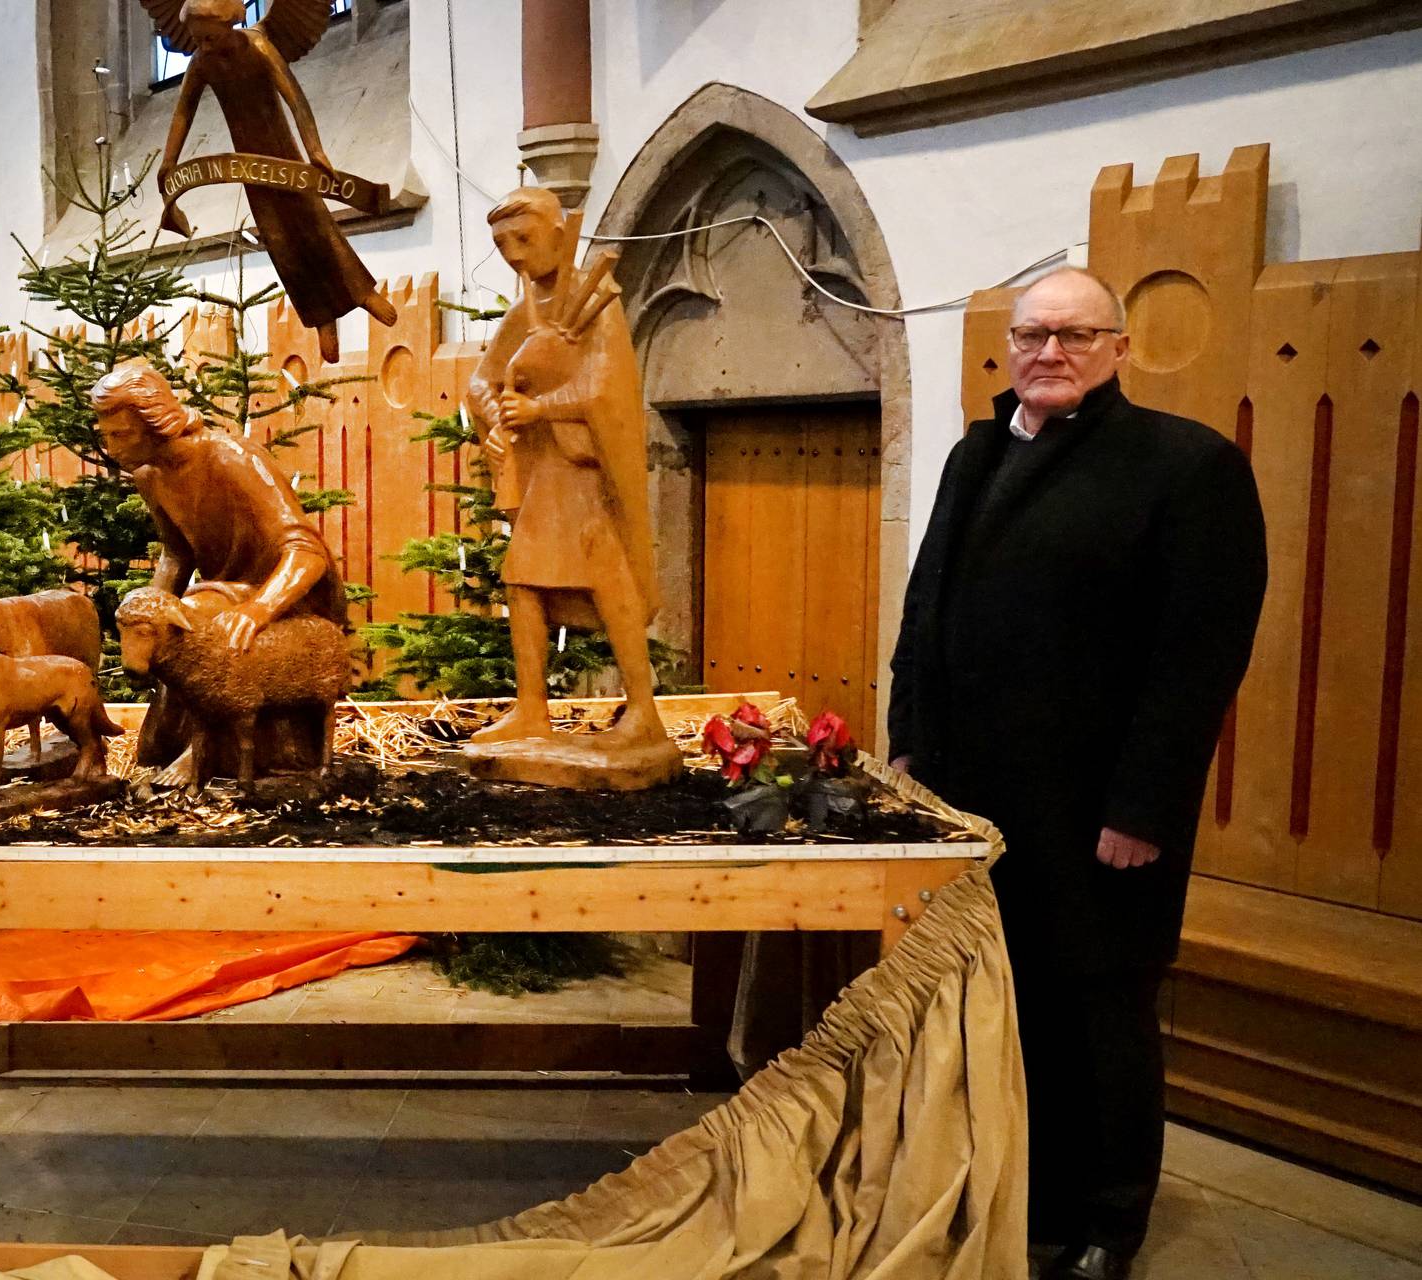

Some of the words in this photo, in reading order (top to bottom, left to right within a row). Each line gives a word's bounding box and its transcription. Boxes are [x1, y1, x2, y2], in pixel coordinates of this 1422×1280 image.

[164, 163, 202, 196] GLORIA
[207, 160, 223, 179] IN
[230, 160, 309, 189] EXCELSIS
[317, 174, 355, 199] DEO
